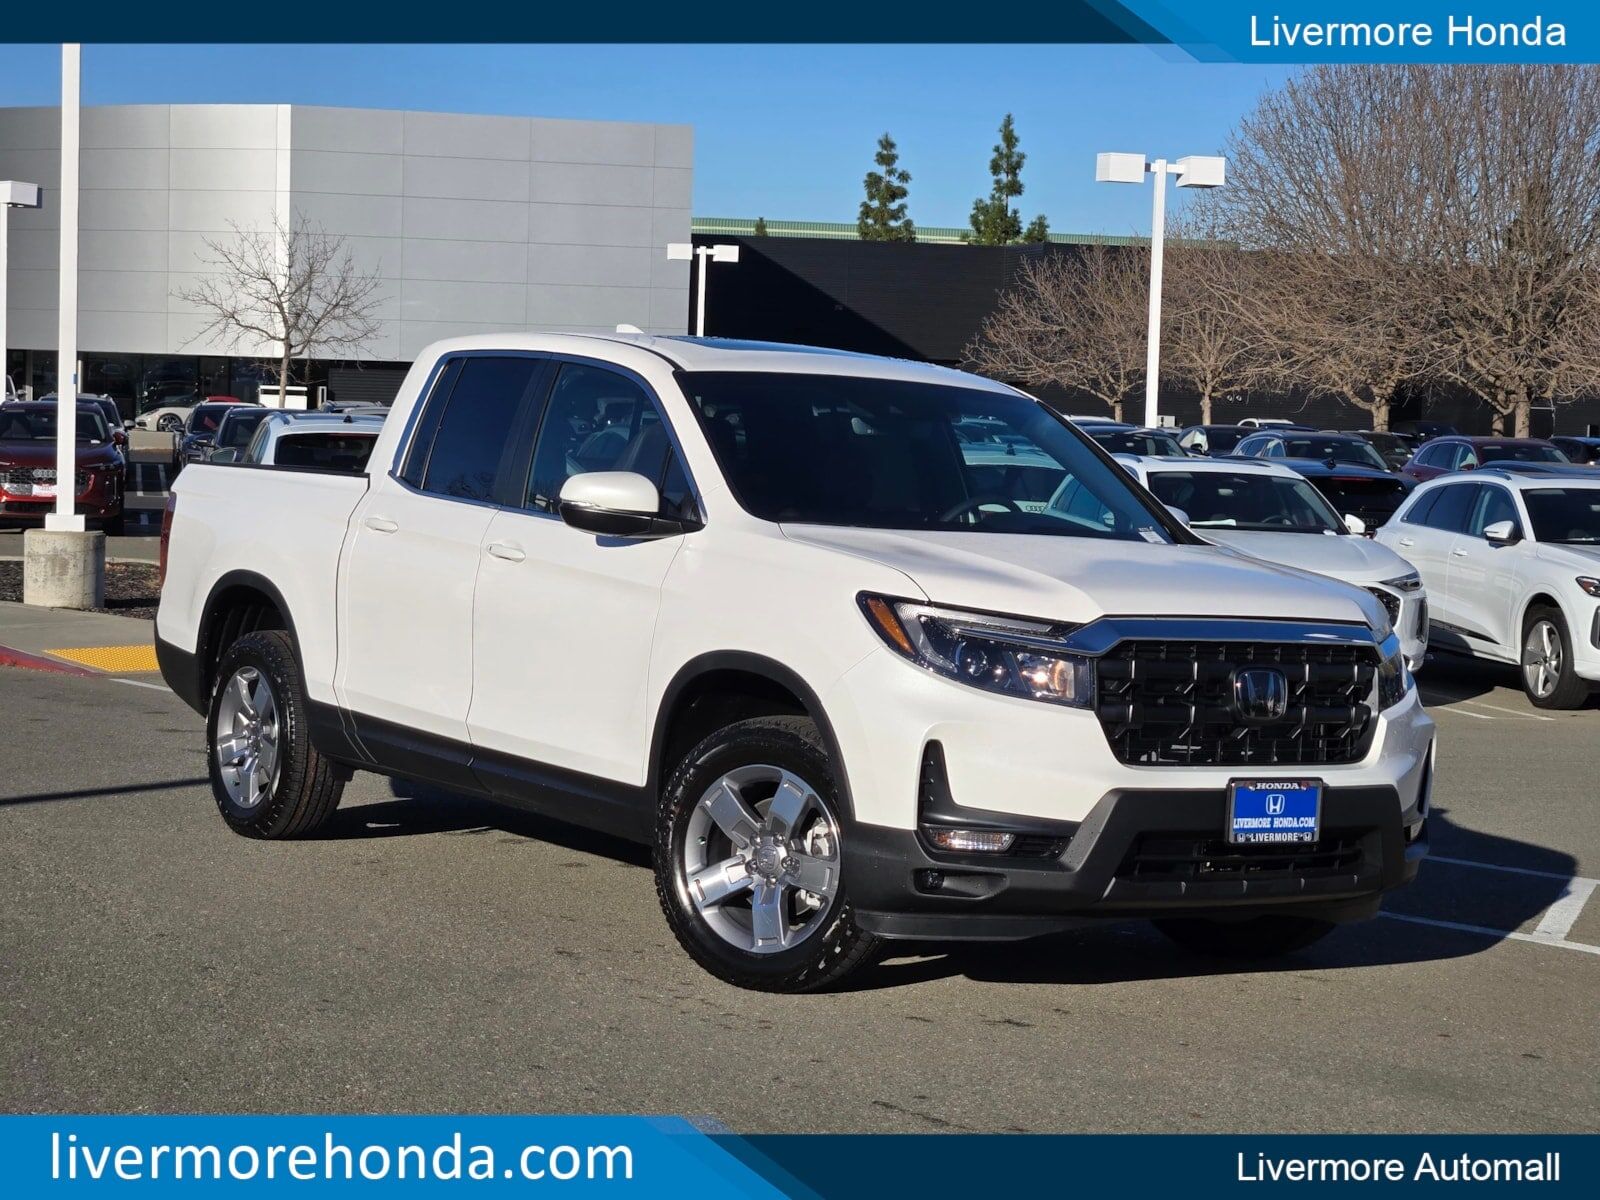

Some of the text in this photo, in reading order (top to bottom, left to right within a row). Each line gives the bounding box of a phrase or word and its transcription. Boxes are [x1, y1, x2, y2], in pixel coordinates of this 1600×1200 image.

[1255, 782, 1299, 790] HONDA
[1233, 817, 1315, 828] LIVERMORE HONDA.COM
[1251, 832, 1298, 842] LIVERMORE
